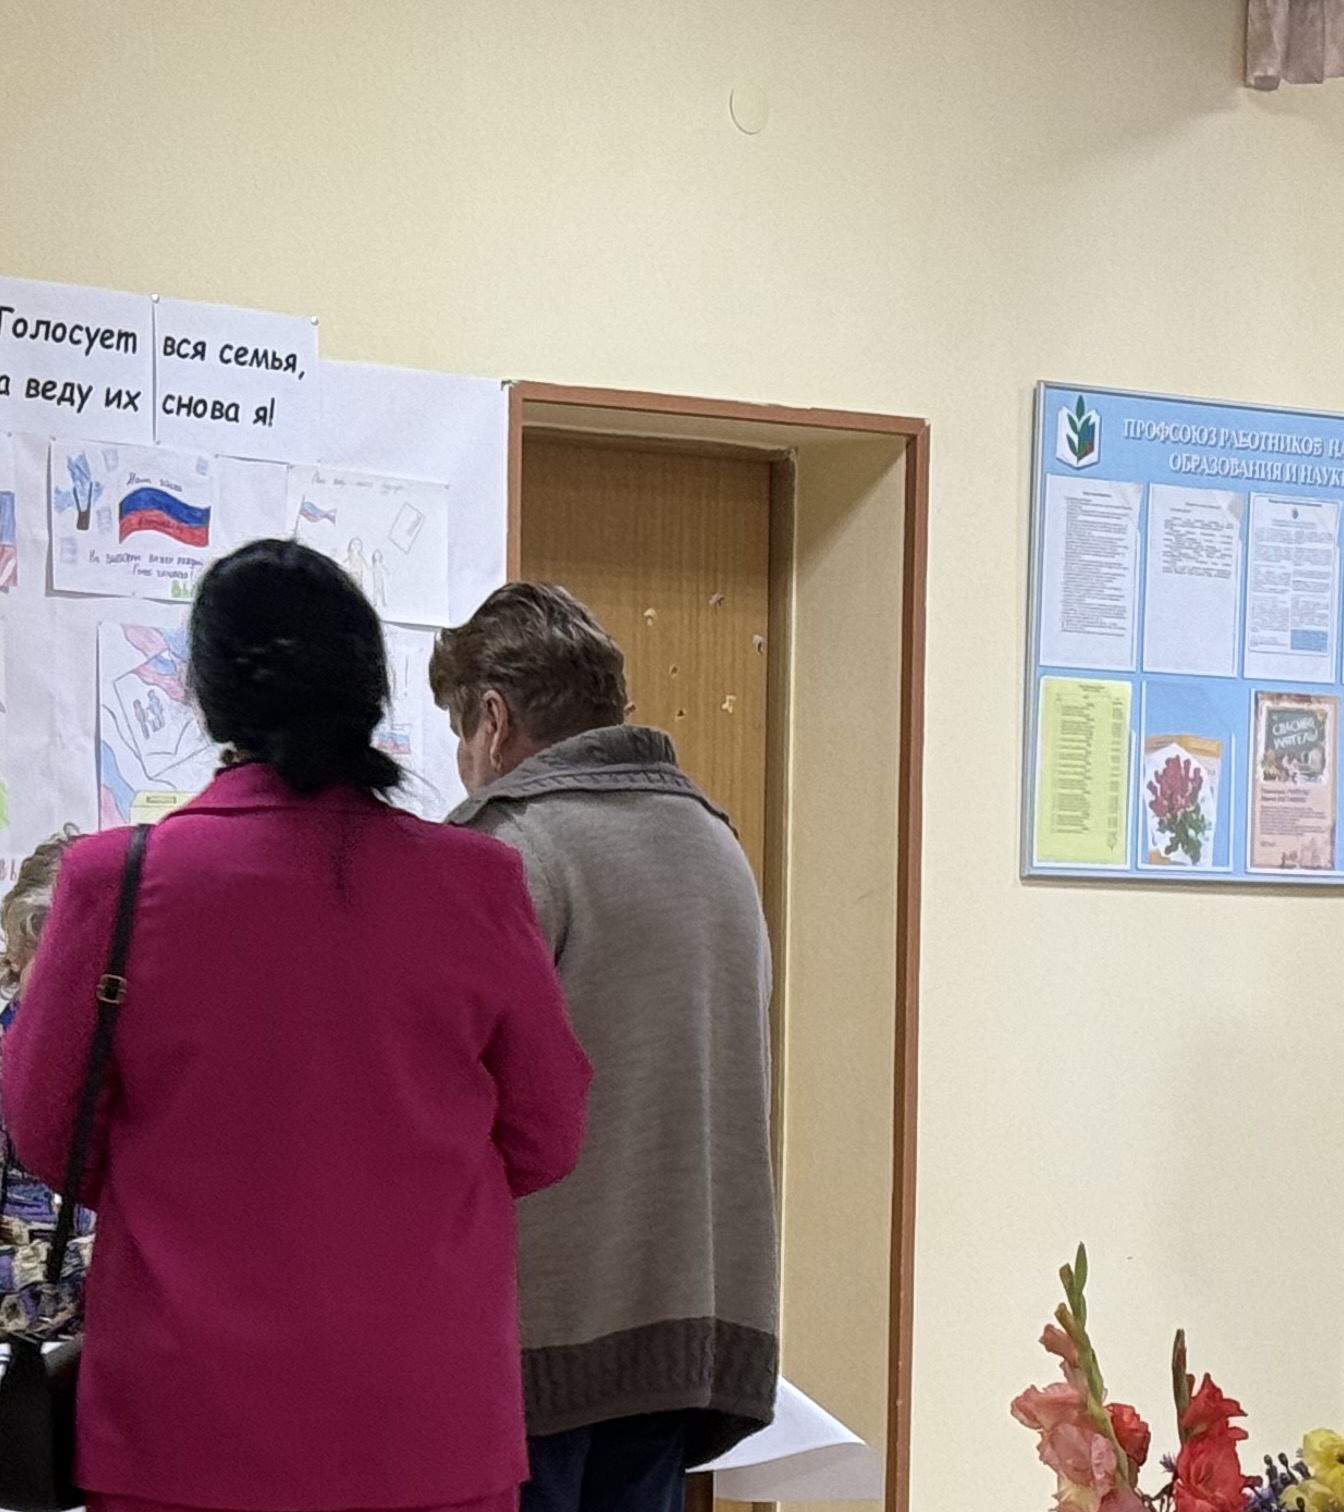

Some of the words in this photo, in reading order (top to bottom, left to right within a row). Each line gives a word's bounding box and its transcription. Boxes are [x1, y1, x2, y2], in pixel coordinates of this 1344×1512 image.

[163, 335, 206, 361] вся
[219, 343, 305, 380] семья,
[25, 378, 92, 413] веду
[105, 387, 141, 412] их
[161, 393, 240, 423] снова
[252, 397, 275, 427] я!
[1123, 418, 1217, 446] ПРОФСОЮЗ
[1219, 428, 1324, 457] РАБОТНИКОВ
[1168, 452, 1282, 482] ОБРАЗОВАНИЯ
[1284, 464, 1299, 484] И
